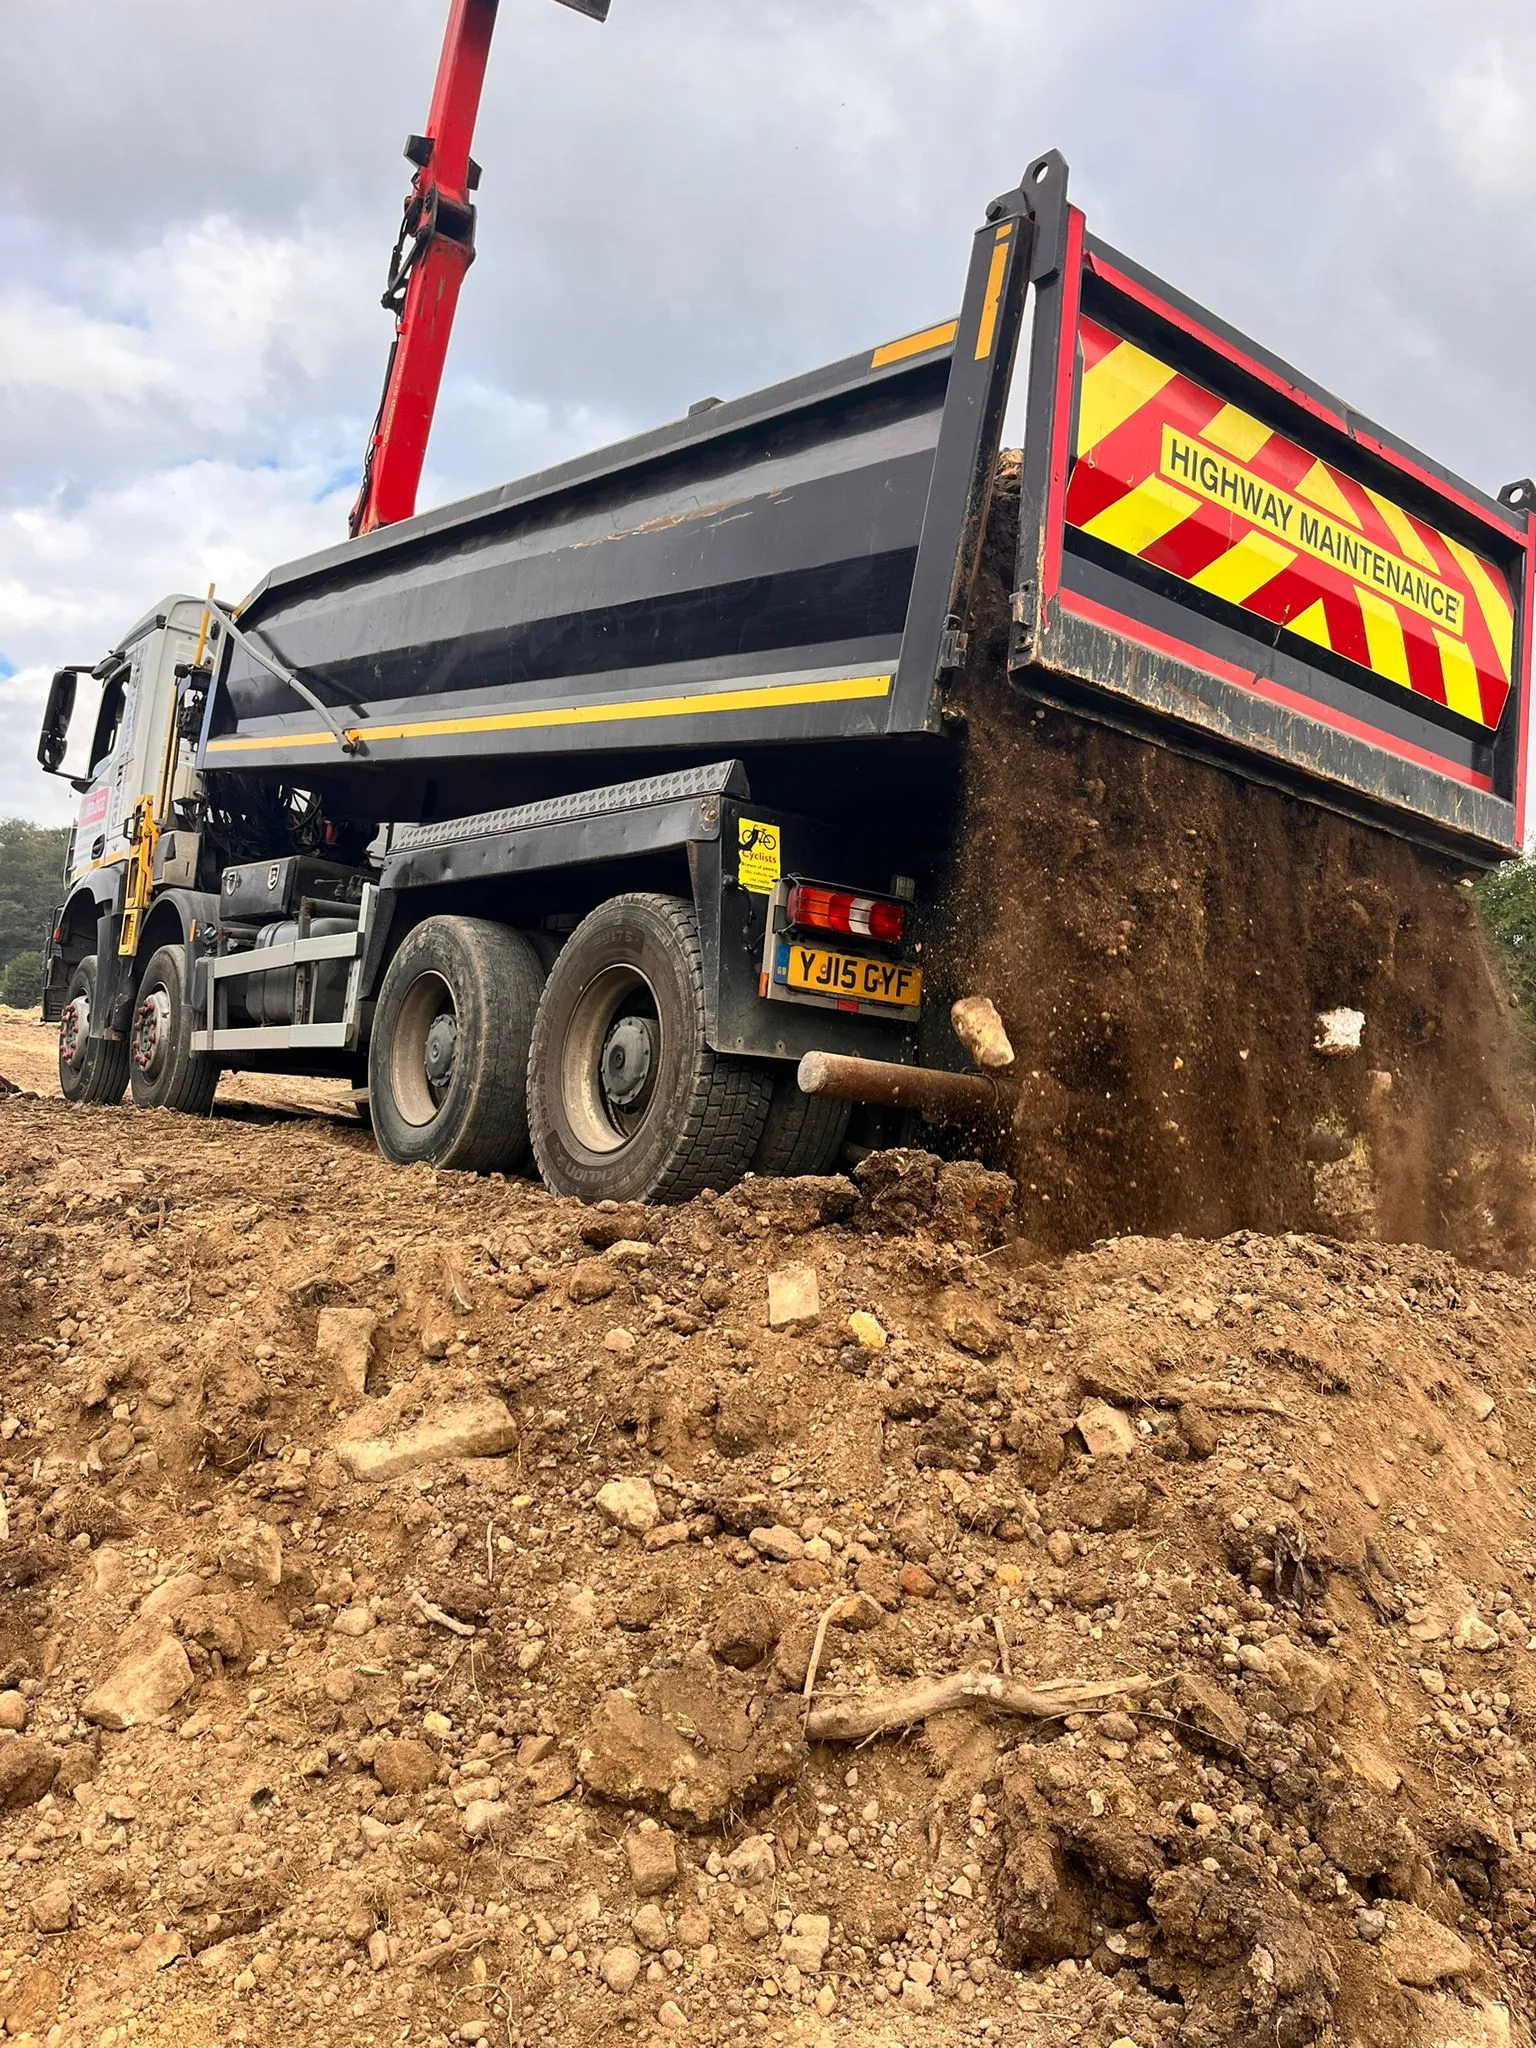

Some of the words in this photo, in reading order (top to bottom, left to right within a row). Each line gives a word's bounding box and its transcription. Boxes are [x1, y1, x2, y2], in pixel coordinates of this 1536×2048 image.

[1169, 438, 1293, 532] HIGHWAY
[1300, 511, 1459, 625] MAINTENANCE
[741, 848, 777, 864] Cyclists
[800, 951, 858, 989] YJ15
[863, 963, 913, 997] GYF
